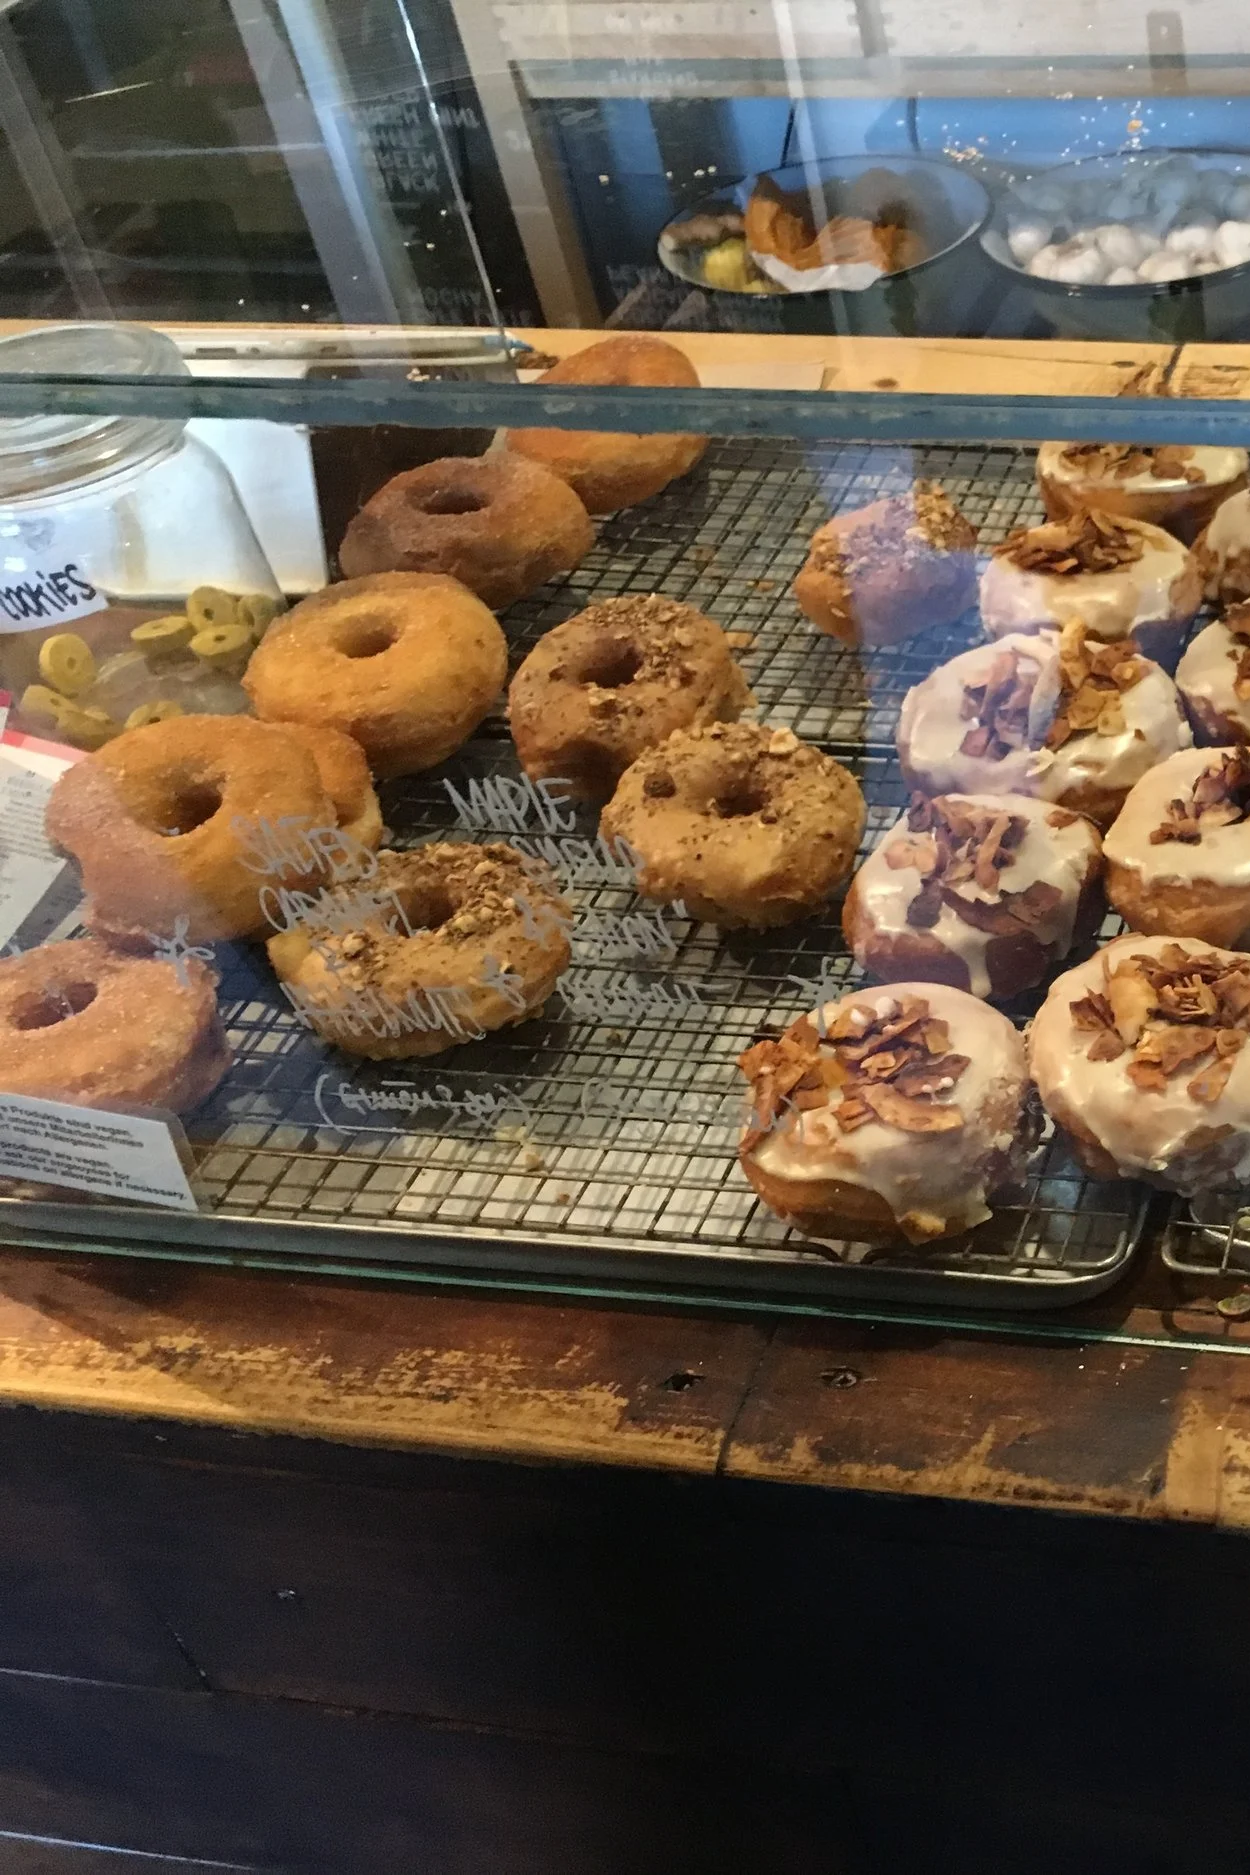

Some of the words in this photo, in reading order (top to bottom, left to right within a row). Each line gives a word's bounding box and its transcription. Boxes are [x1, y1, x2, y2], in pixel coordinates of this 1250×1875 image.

[442, 772, 577, 833] MAPLE
[230, 816, 378, 881] SALTED
[113, 1170, 130, 1181] for
